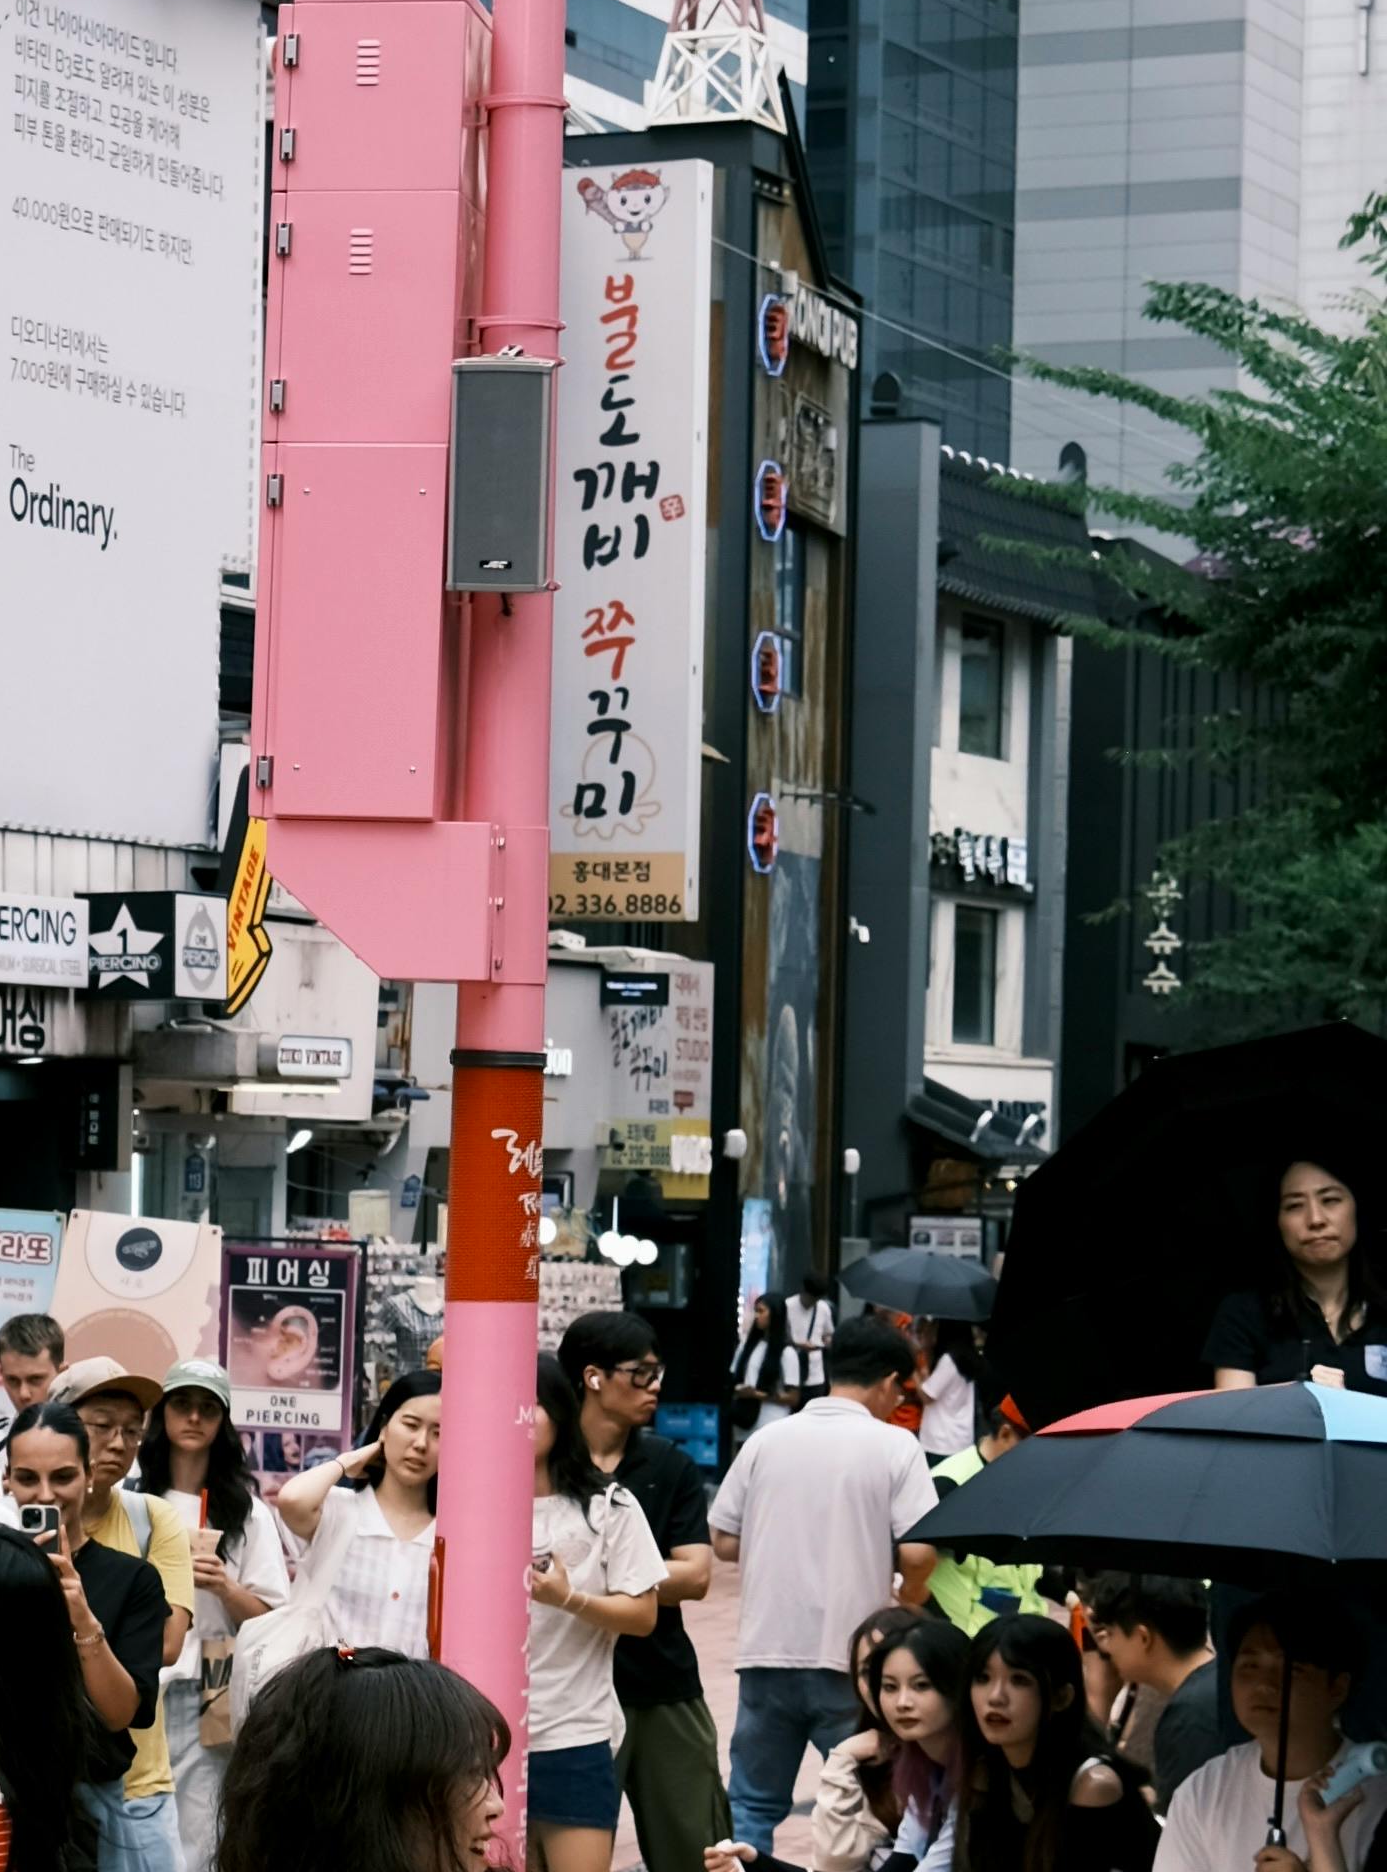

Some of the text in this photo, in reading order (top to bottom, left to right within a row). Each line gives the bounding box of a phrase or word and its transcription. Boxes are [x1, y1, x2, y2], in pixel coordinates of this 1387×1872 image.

[13, 34, 52, 71] 비타민
[98, 61, 134, 95] 알려져
[137, 74, 160, 107] 있는
[163, 82, 176, 112] 이
[177, 88, 212, 124] 성분은
[13, 73, 51, 110] 피지를
[108, 103, 143, 140] 모공을
[13, 112, 38, 144] 피부
[41, 119, 66, 154] 톤을
[69, 128, 105, 163] 환하고
[107, 140, 155, 179] 균일하게
[97, 213, 156, 253] 판매되기도
[10, 315, 109, 365] 디오디너리에서는
[75, 367, 123, 405] 구매하실
[125, 378, 138, 407] 수
[572, 273, 660, 571] 불도깨비
[9, 442, 36, 473] The
[9, 476, 118, 553] Ordinary.
[572, 599, 637, 819] 쭈꾸미
[571, 860, 651, 882] 홍대본점
[228, 843, 260, 953] VINTAGE
[547, 894, 682, 915] 2.336.8886
[116, 928, 128, 955] 1
[59, 958, 83, 977] STEEL
[88, 955, 161, 970] PIERCING
[304, 1048, 343, 1067] VINTAGE
[245, 1408, 321, 1426] PIERCING
[269, 1395, 297, 1409] ONE
